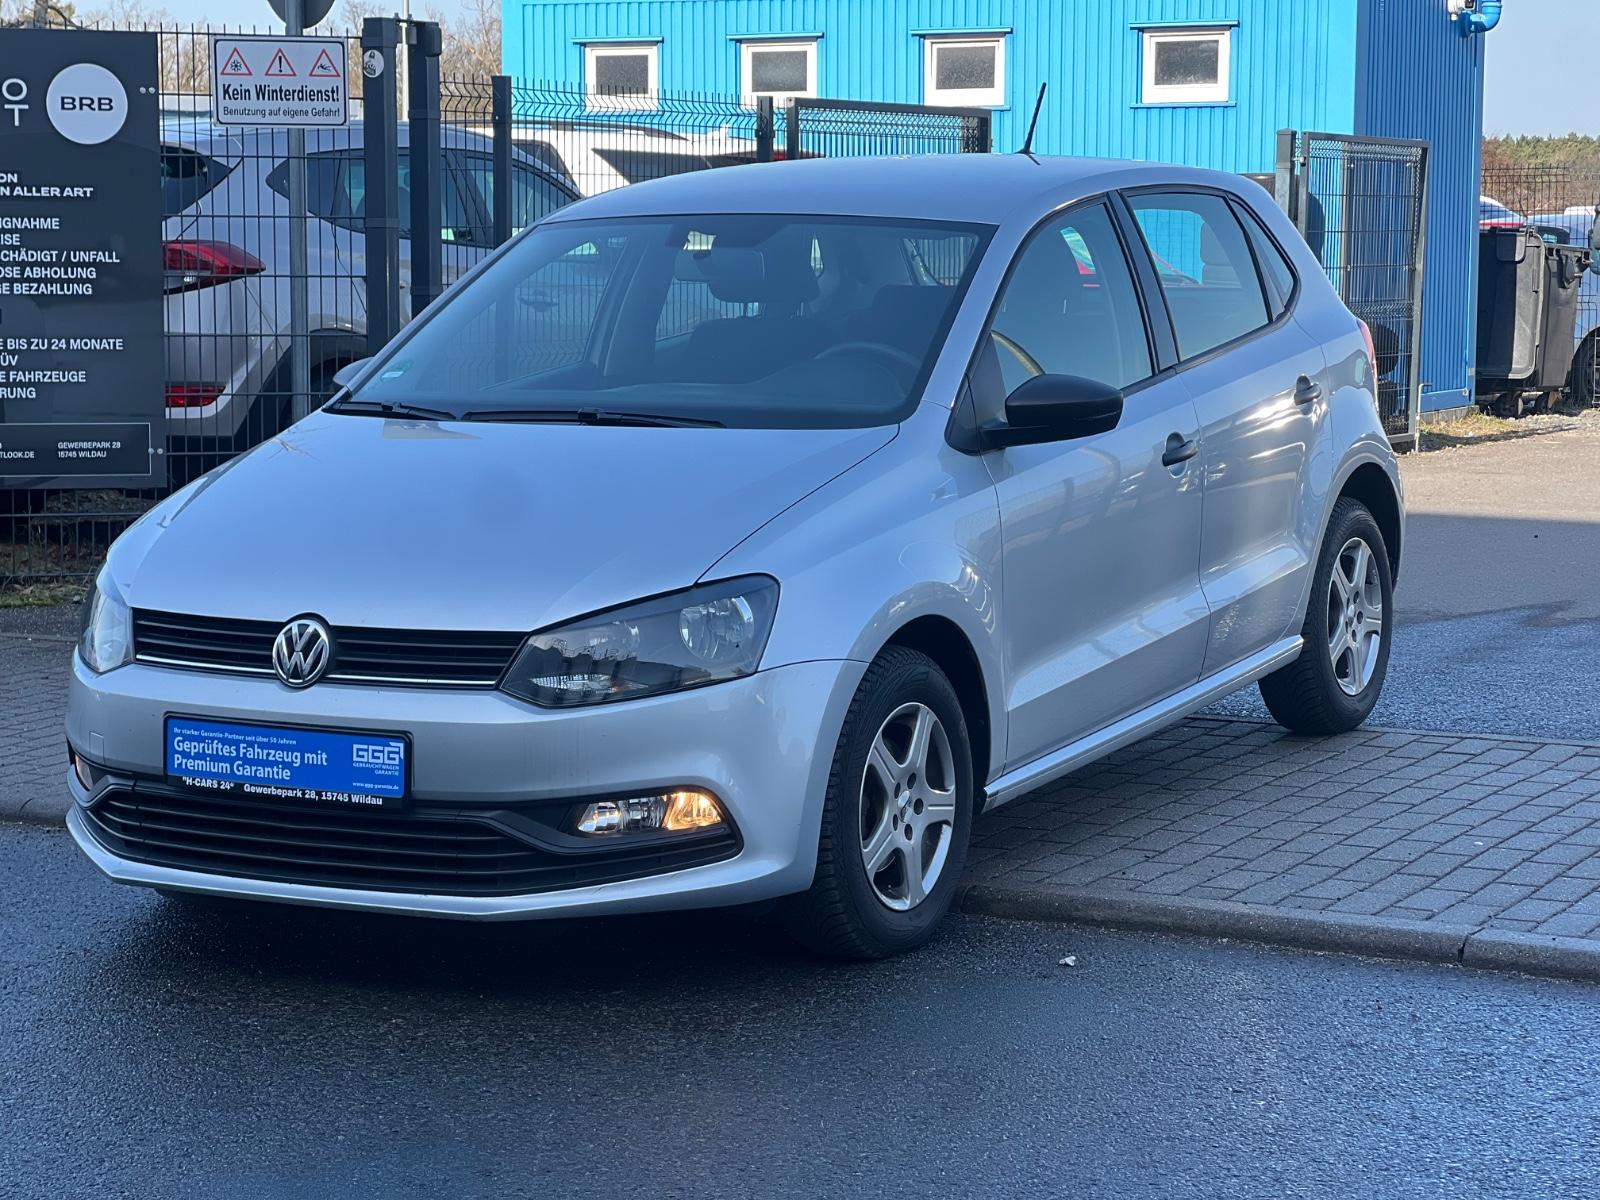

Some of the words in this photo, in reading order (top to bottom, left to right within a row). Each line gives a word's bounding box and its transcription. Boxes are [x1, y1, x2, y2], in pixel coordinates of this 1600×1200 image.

[223, 84, 251, 100] Kein
[254, 84, 340, 102] Winterdienst!
[60, 96, 114, 112] BRB
[223, 106, 266, 118] Benutzung
[268, 107, 281, 117] auf
[282, 108, 309, 119] eigene
[311, 107, 340, 118] Gefahr!
[15, 187, 61, 197] ALLER
[63, 187, 94, 198] ART
[0, 217, 60, 230] GNAHME
[61, 250, 67, 262] /
[70, 251, 120, 263] UNFALL
[24, 267, 97, 279] ABHOLUNG
[13, 283, 93, 295] BEZAHLUNG
[7, 338, 28, 350] BIS
[30, 338, 48, 350] ZU
[50, 338, 67, 350] 24
[69, 338, 124, 350] MONATE
[9, 371, 86, 383] FAHRZEUGE
[58, 441, 111, 449] GEWERBEPARK
[112, 441, 121, 449] 28
[58, 450, 77, 459] 15745
[78, 450, 107, 459] WILDAU
[278, 737, 297, 745] Jahren
[174, 736, 236, 757] Geprüftes
[239, 744, 301, 766] Fahrzeug
[304, 749, 328, 766] mit
[353, 743, 399, 765] GGG
[174, 753, 230, 775] Premium
[233, 761, 291, 780] Garantie
[243, 783, 303, 798] Gewerbepark
[304, 789, 320, 801] 28,
[321, 791, 349, 802] 15745
[351, 793, 383, 805] Wildau
